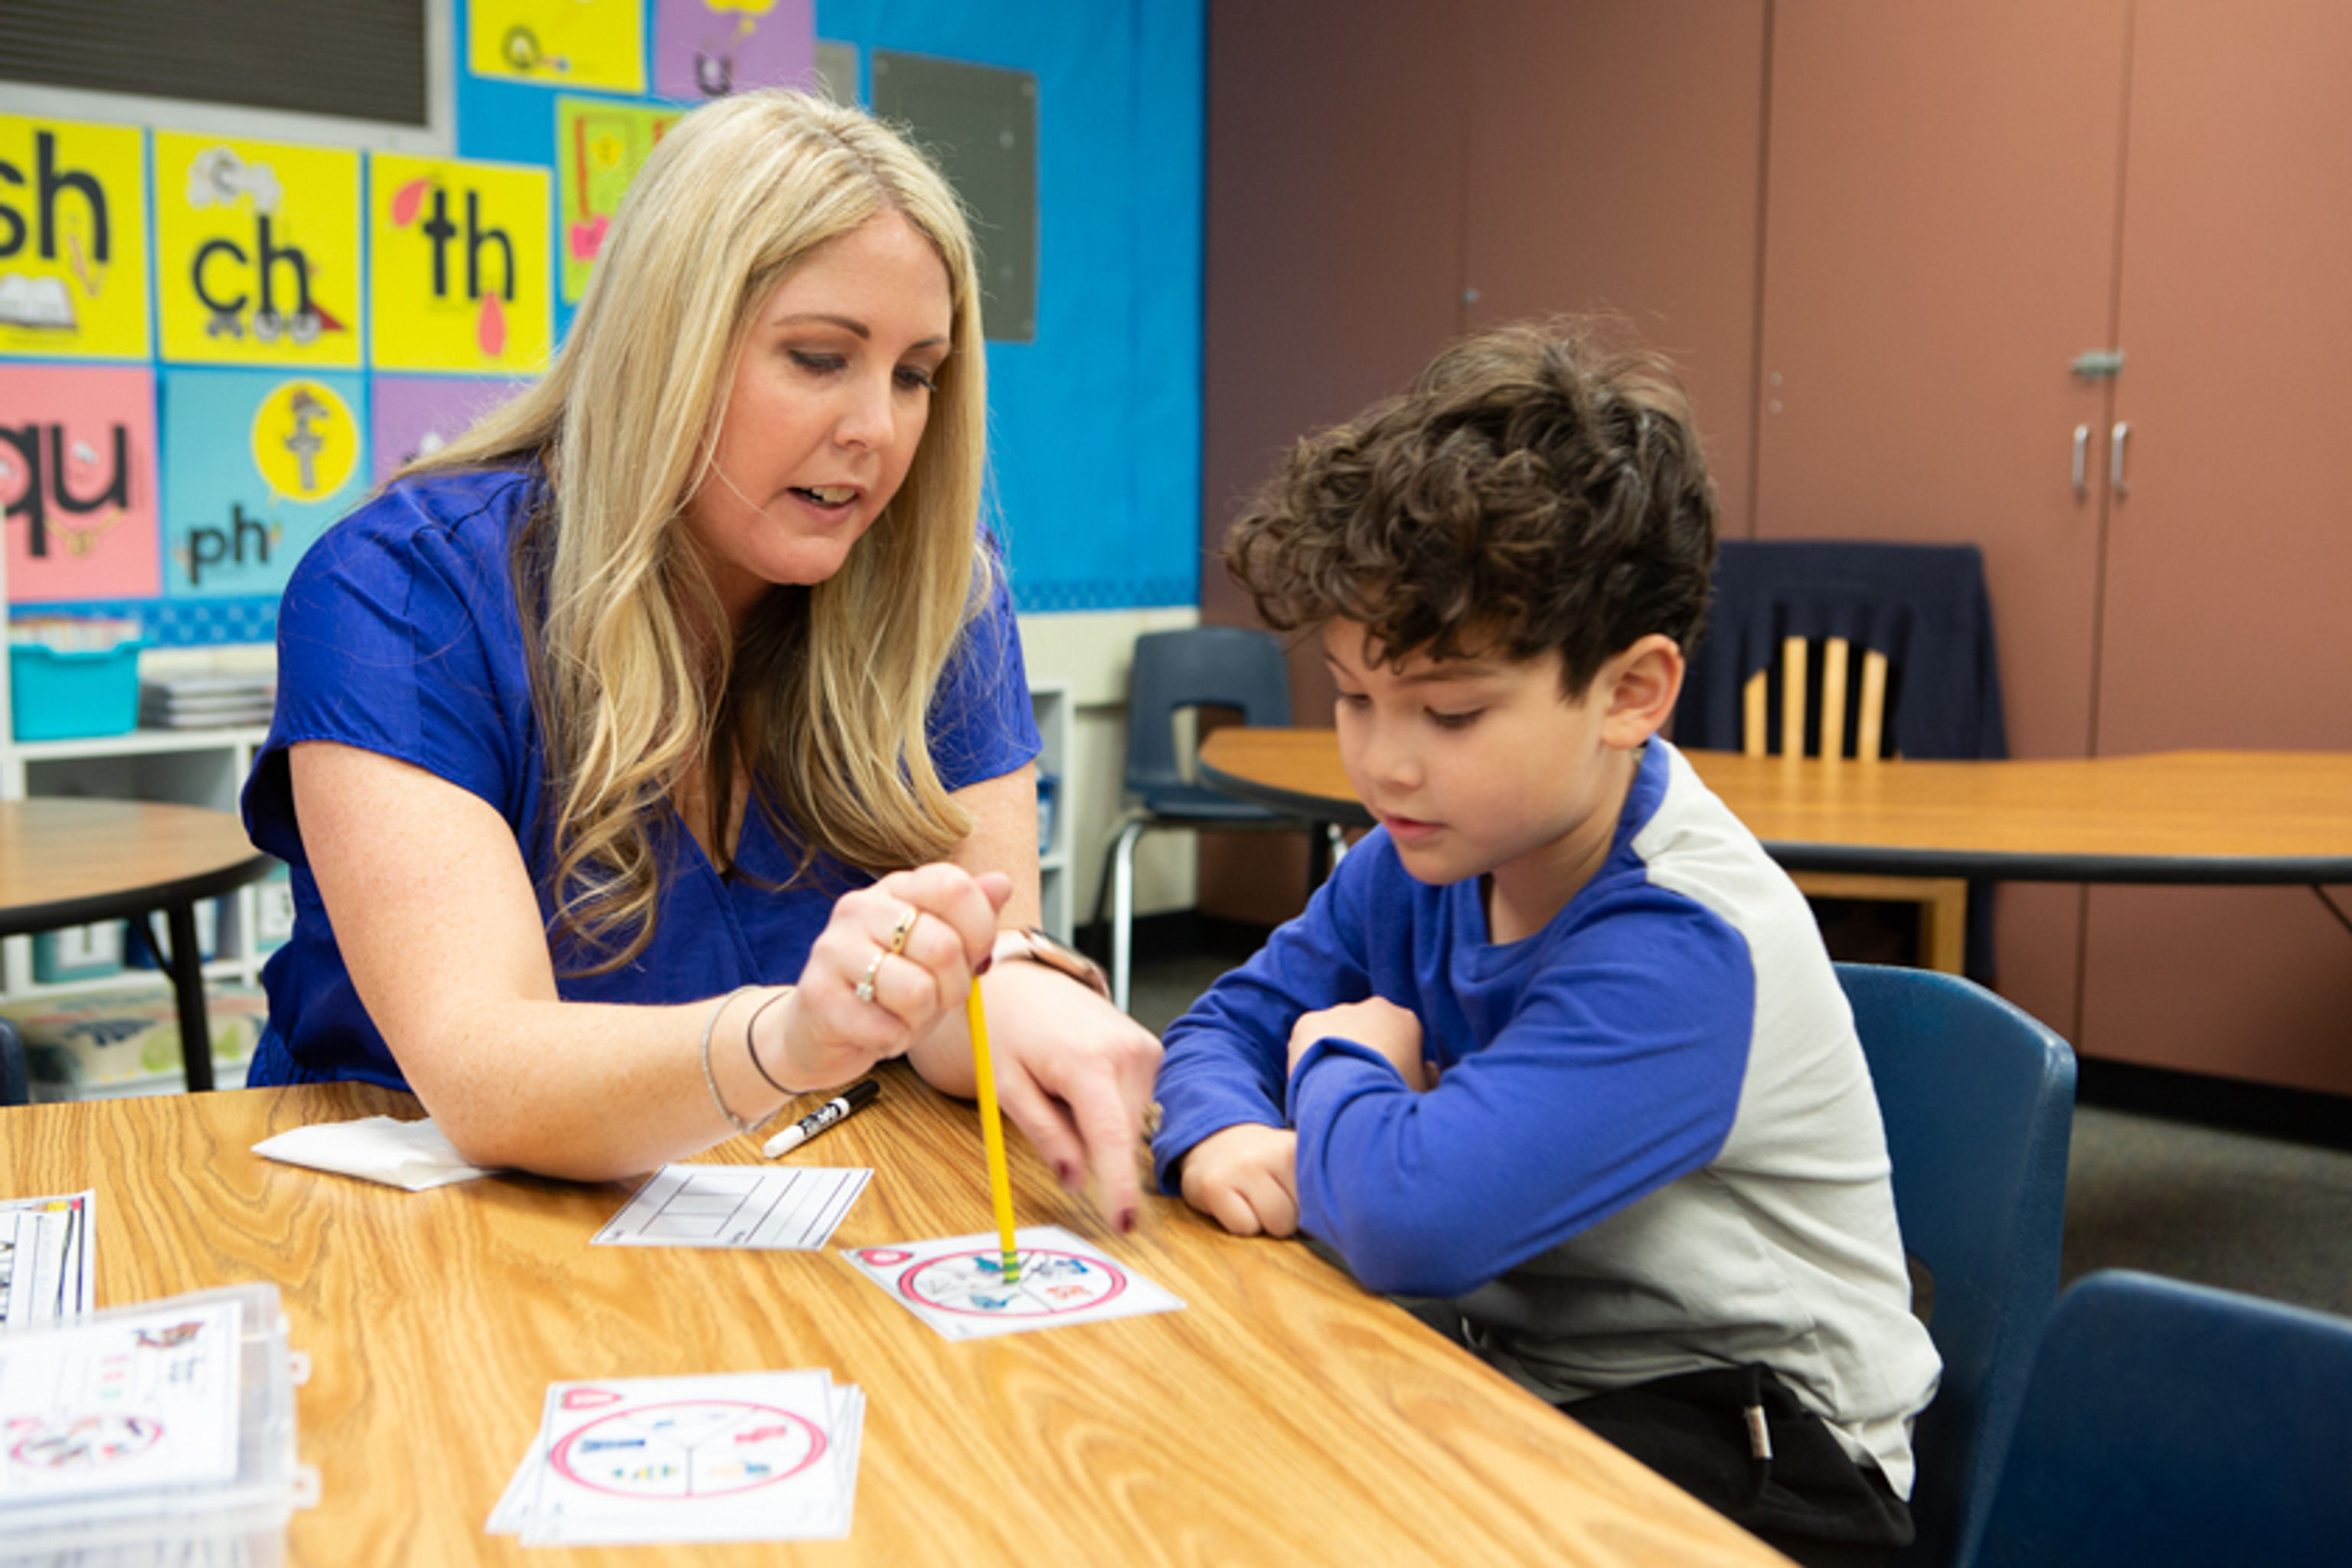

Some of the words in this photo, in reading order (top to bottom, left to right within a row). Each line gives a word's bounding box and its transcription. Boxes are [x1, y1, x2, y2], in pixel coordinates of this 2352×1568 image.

[191, 214, 311, 316] ch
[423, 188, 514, 302] th
[189, 503, 269, 586] ph
